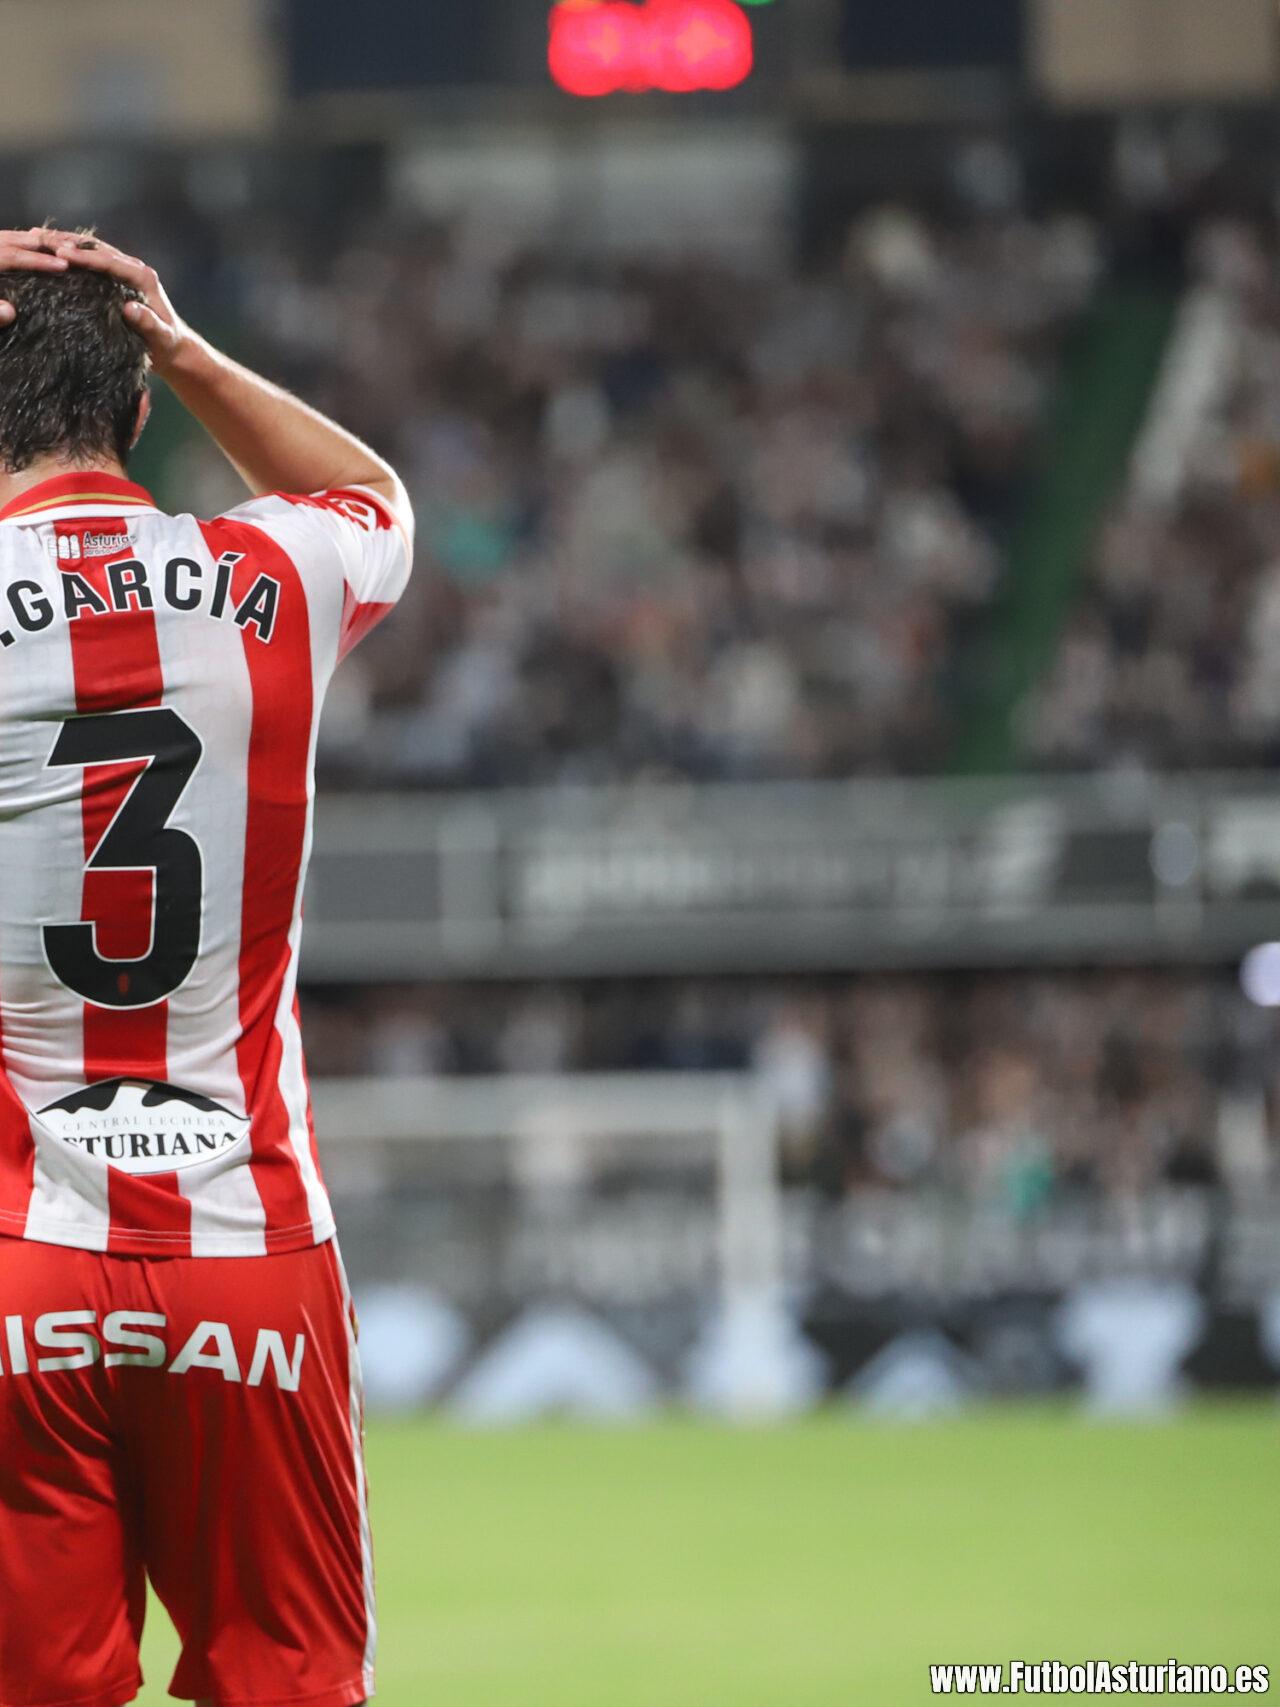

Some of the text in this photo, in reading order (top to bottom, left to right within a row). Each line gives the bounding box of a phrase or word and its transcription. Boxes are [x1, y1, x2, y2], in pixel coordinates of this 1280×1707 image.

[39, 707, 203, 1010] 3
[62, 1114, 227, 1132] CENTRAL LECHERA
